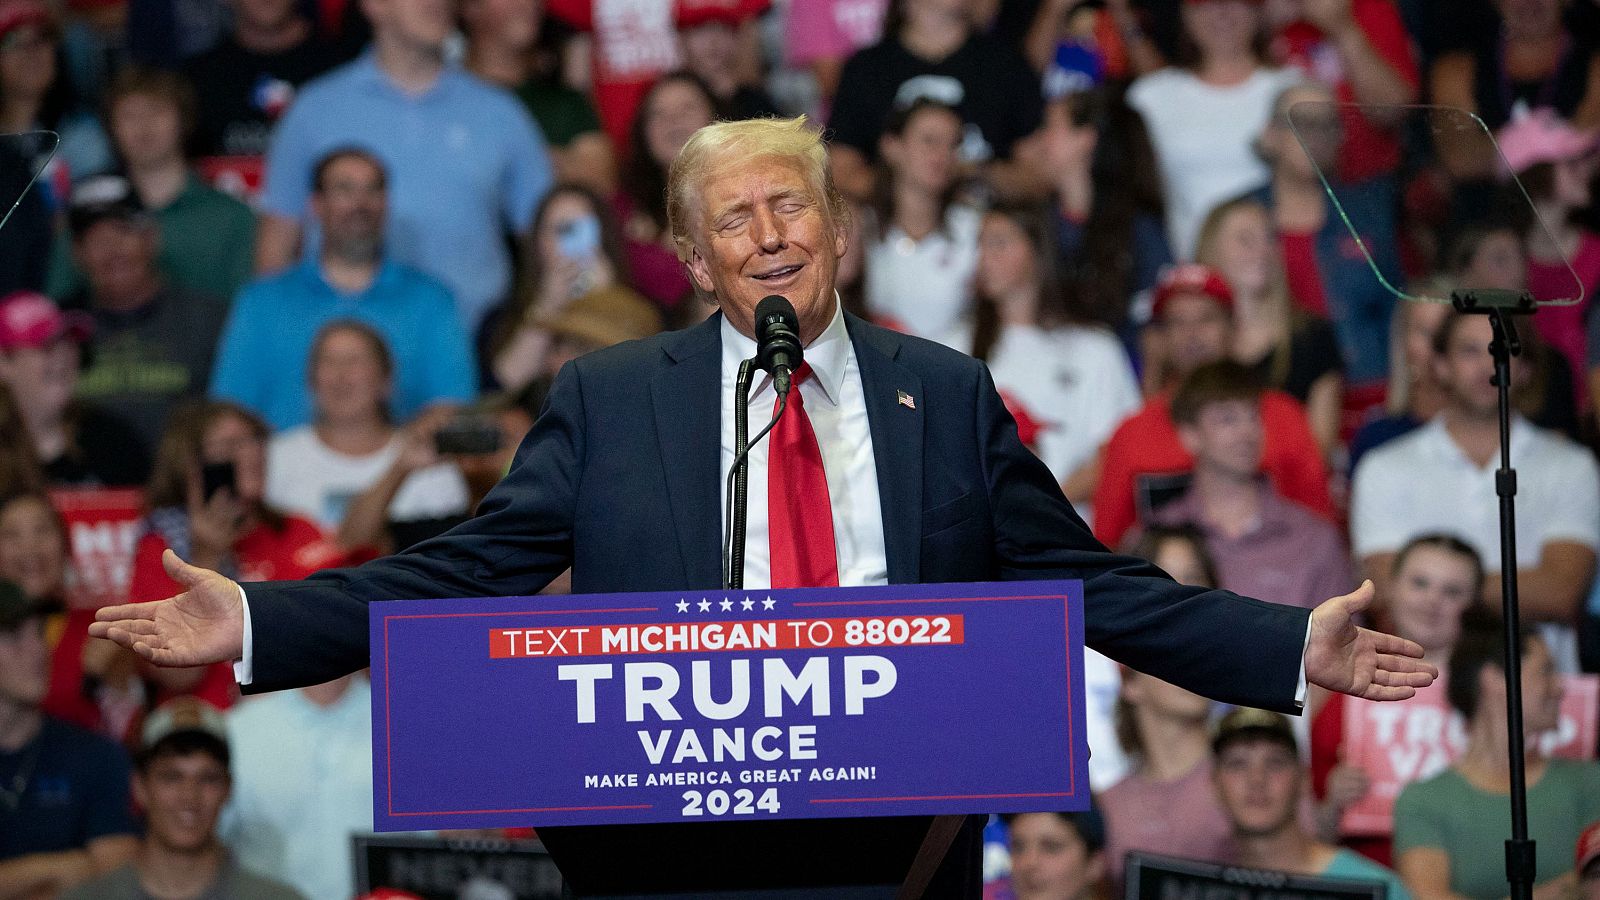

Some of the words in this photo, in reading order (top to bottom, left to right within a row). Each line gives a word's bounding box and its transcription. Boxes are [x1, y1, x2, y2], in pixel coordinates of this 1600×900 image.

[502, 628, 590, 656] TEXT
[601, 622, 777, 653] MICHIGAN
[786, 620, 833, 647] TO
[844, 616, 952, 646] 88022
[558, 655, 898, 724] TRUMP
[637, 725, 818, 765] VANCE
[584, 773, 638, 789] MAKE
[645, 771, 733, 787] AMERICA
[739, 768, 802, 784] GREAT
[808, 766, 876, 783] AGAIN!
[681, 787, 781, 816] 2024
